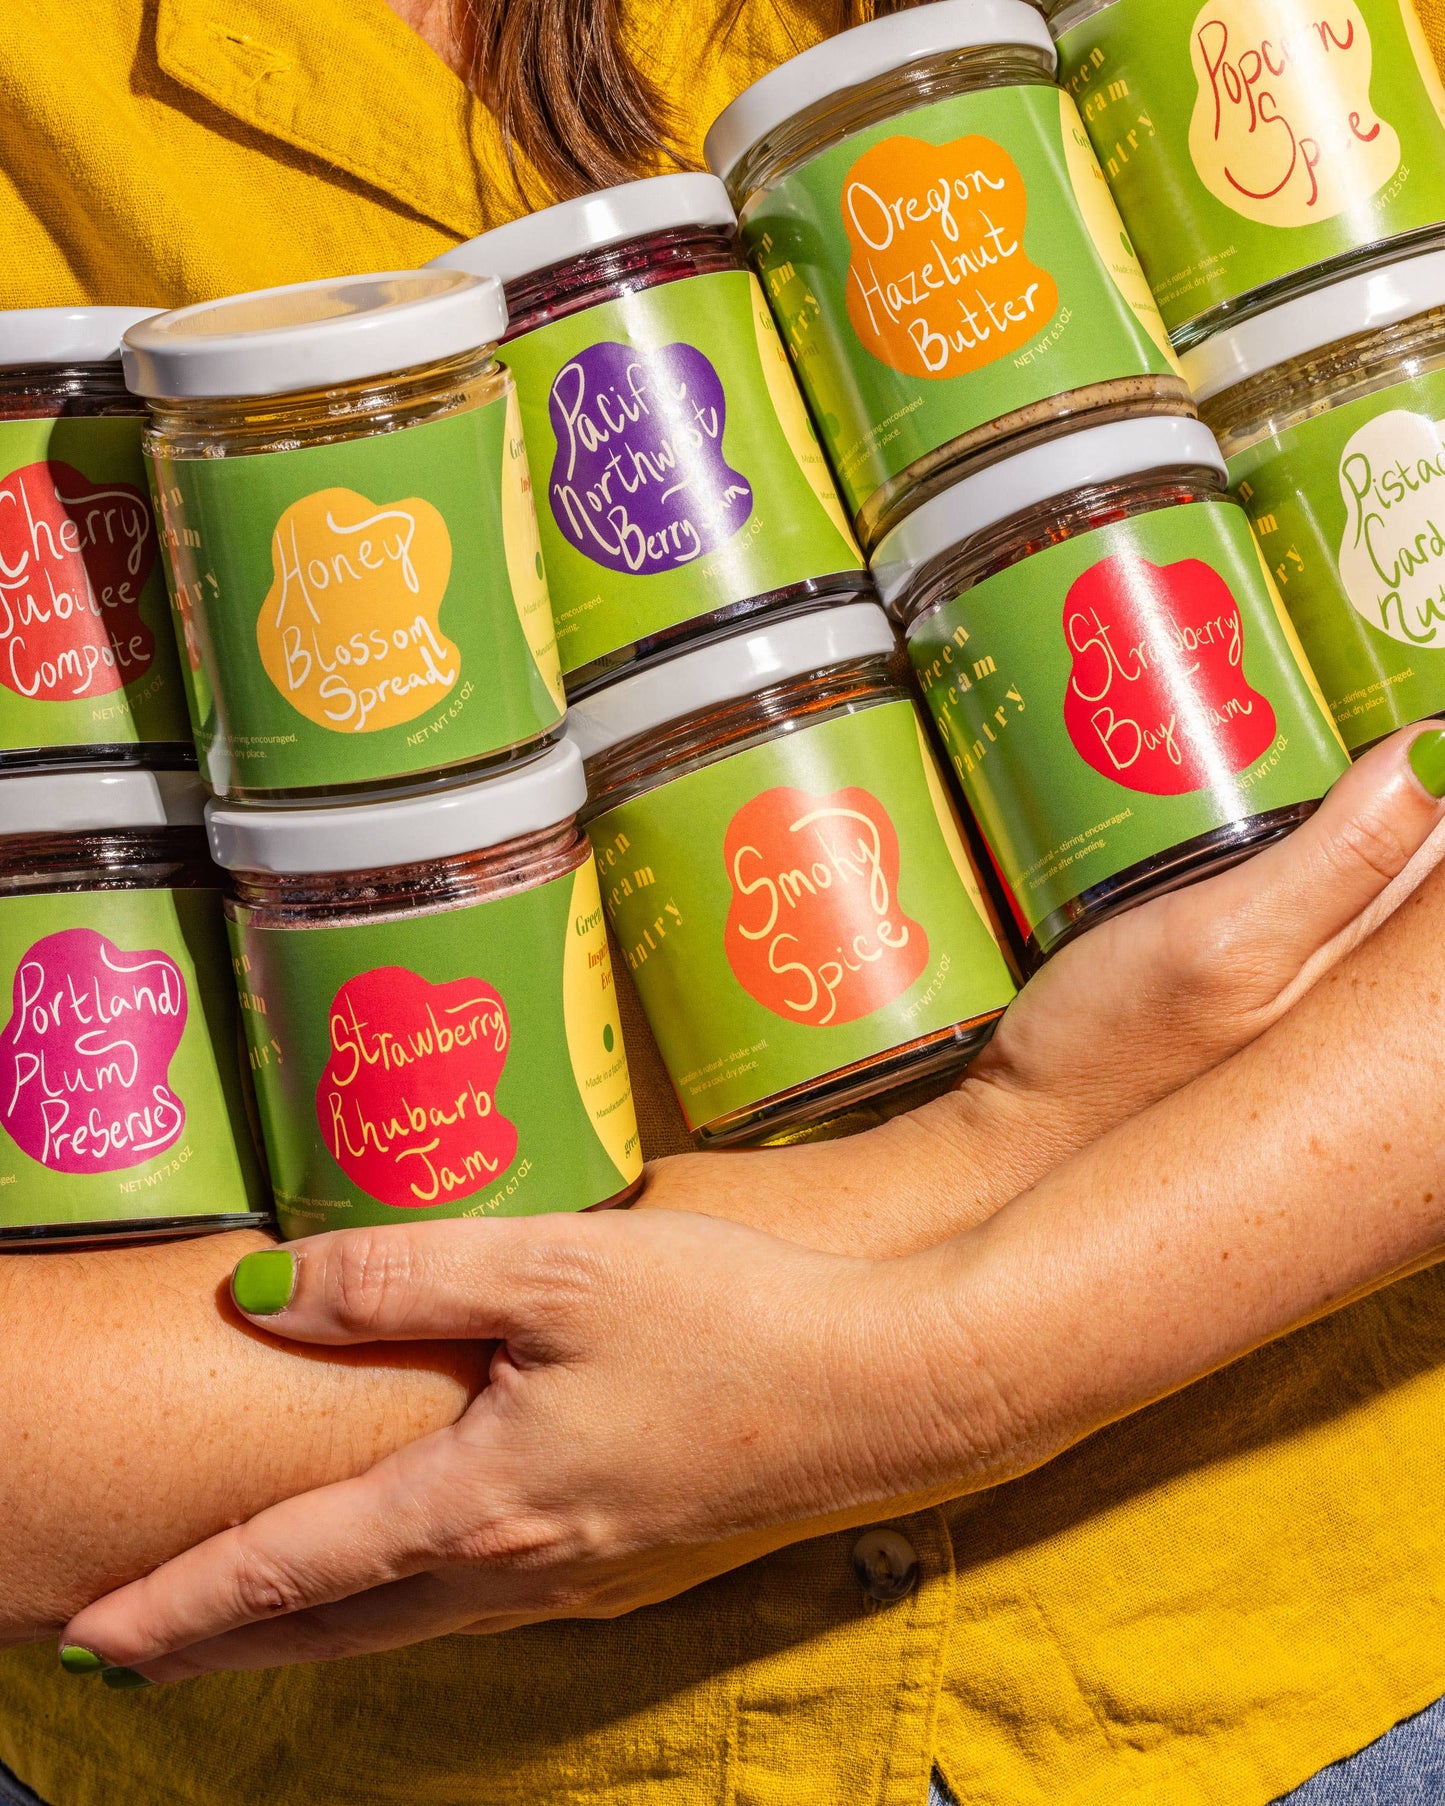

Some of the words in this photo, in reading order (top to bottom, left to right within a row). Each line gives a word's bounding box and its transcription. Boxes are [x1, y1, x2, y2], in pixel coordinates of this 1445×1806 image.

[1064, 47, 1106, 95] reen
[1197, 19, 1354, 141] Popcn
[1224, 92, 1380, 206] Spe
[1398, 164, 1411, 182] OZ
[847, 169, 1005, 251] Oregon
[850, 209, 1018, 337] Hazelnut
[907, 283, 1039, 372] Butter
[1013, 349, 1036, 369] NET
[1033, 336, 1053, 354] WT
[1050, 322, 1065, 340] 6.3
[1059, 306, 1073, 324] OZ
[552, 363, 687, 481] Pacifc
[882, 396, 926, 428] encouraged.
[0, 476, 150, 578] Cherry
[607, 505, 701, 571] Berry
[750, 516, 764, 534] OZ
[0, 557, 137, 639] Jubilee
[276, 511, 420, 628] Honey
[560, 594, 605, 622] encouraged.
[9, 632, 151, 697] Compote
[281, 615, 447, 690] Blossom
[1342, 687, 1369, 705] stirring
[1367, 667, 1416, 694] encouraged.
[92, 706, 115, 720] NET
[116, 698, 136, 716] WT
[319, 645, 456, 731] Spread
[406, 727, 429, 747] NET
[429, 713, 449, 733] WT
[449, 699, 464, 718] 6.3
[460, 680, 475, 700] OZ
[1352, 704, 1365, 716] dry
[1364, 695, 1388, 712] place.
[250, 733, 298, 745] encouraged.
[953, 682, 1026, 780] Pantry
[1091, 706, 1182, 771] Bay
[1253, 761, 1271, 779] WT
[1268, 748, 1281, 766] 6.7
[1276, 734, 1289, 752] OZ
[1059, 855, 1075, 871] after
[1074, 838, 1107, 860] opening.
[1060, 833, 1085, 853] stirring
[1084, 807, 1134, 838] encouraged.
[606, 866, 655, 918] ream
[733, 808, 889, 940] Smoky
[627, 896, 683, 971] antry
[13, 944, 181, 1045] Portland
[768, 918, 909, 1025] Spice
[901, 1001, 922, 1022] NET
[920, 986, 936, 1005] WT
[932, 970, 946, 989] 3.5
[940, 953, 951, 972] OZ
[8, 1030, 139, 1117] Plum
[331, 993, 507, 1087] Strawberry
[328, 1080, 495, 1159] Rhubarb
[119, 1180, 141, 1194] NET
[143, 1169, 163, 1187] WT
[163, 1159, 180, 1177] 7.8
[178, 1144, 194, 1163] OZ
[396, 1138, 498, 1200] Jam
[462, 1204, 486, 1218] NET
[486, 1191, 505, 1210] WT
[505, 1176, 519, 1195] 6.7
[517, 1158, 533, 1178] OZ
